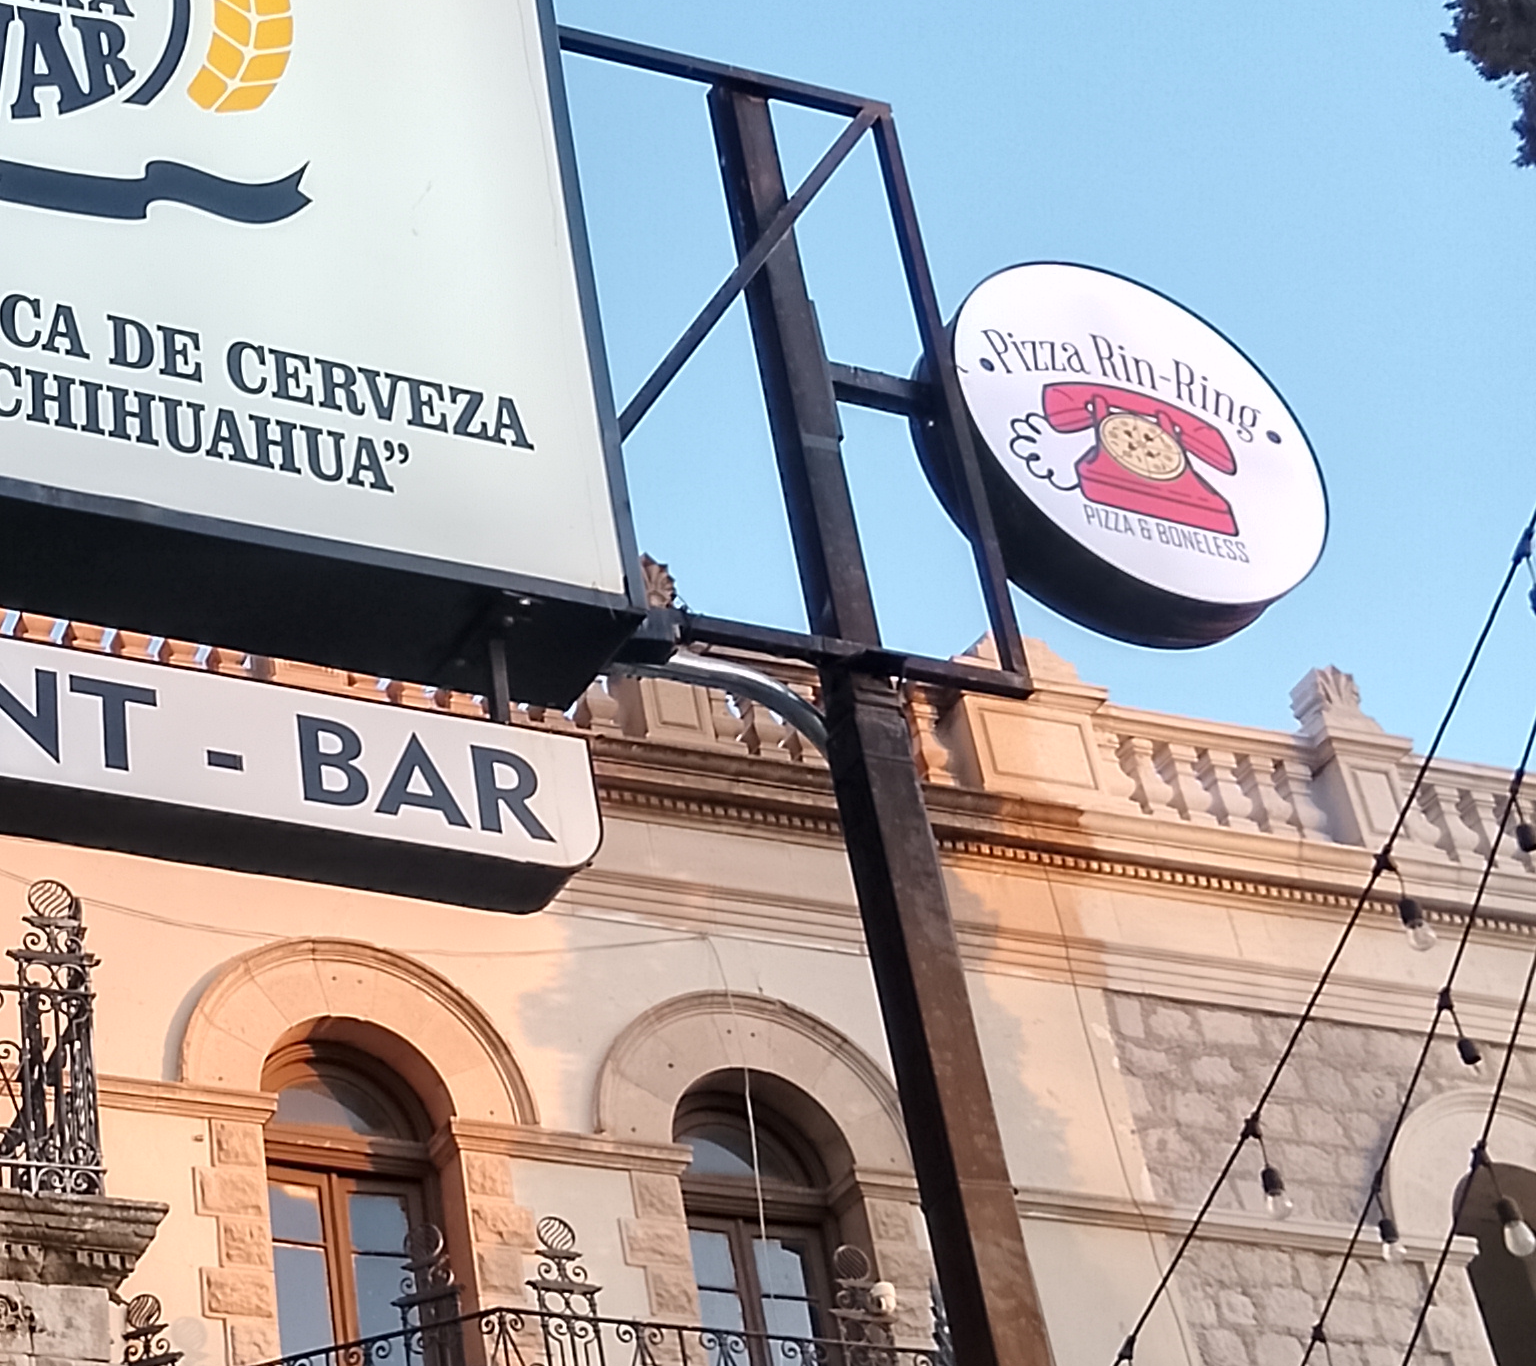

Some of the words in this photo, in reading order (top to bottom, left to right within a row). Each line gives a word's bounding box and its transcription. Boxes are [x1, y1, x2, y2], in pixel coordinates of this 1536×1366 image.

[107, 313, 203, 383] DE
[225, 340, 535, 451] CERVEZA
[981, 328, 1090, 375] Pizza
[1089, 333, 1261, 443] Rin-Ring
[1083, 503, 1135, 537] PIZZA
[1137, 517, 1153, 541] &
[1155, 522, 1251, 564] BONELESS
[207, 749, 244, 773] -
[298, 715, 557, 843] BAR
